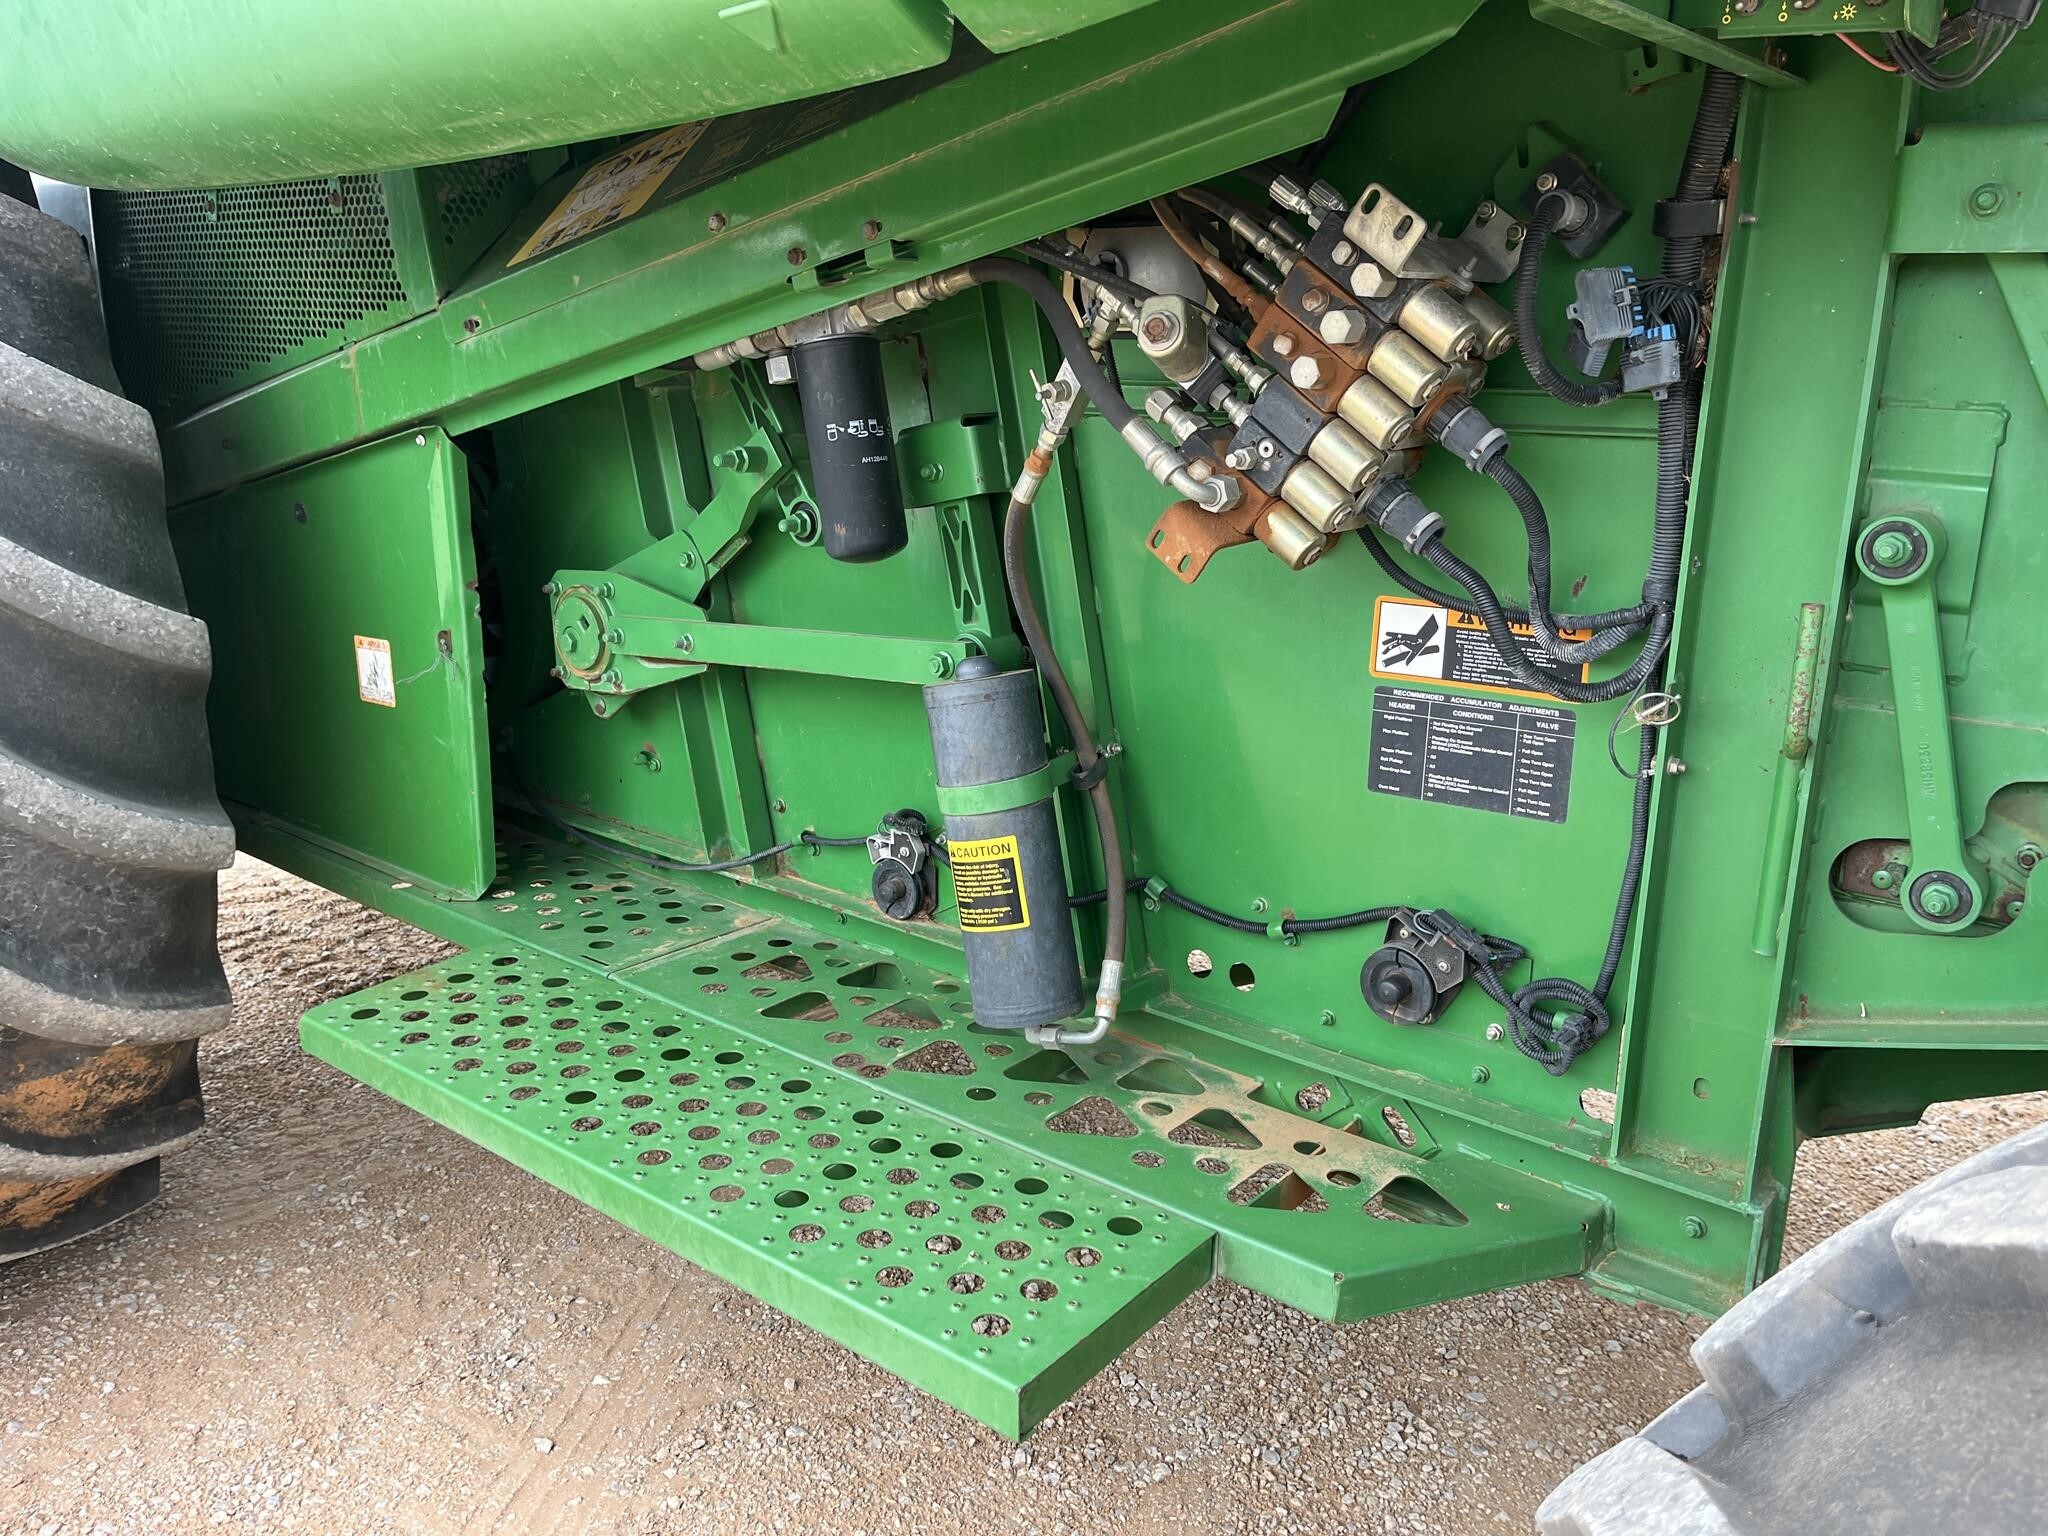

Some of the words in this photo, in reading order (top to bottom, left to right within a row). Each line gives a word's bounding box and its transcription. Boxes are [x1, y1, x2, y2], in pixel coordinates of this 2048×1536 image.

[1389, 702, 1416, 710] HEADER
[1393, 689, 1445, 701] RECOMMENDED
[1450, 697, 1502, 709] ACCUMULATOR
[1509, 704, 1560, 717] ADJUSTMENTS
[1453, 710, 1495, 721] CONDITIONS
[1536, 721, 1560, 731] VALVE
[957, 843, 1011, 858] CAUTION
